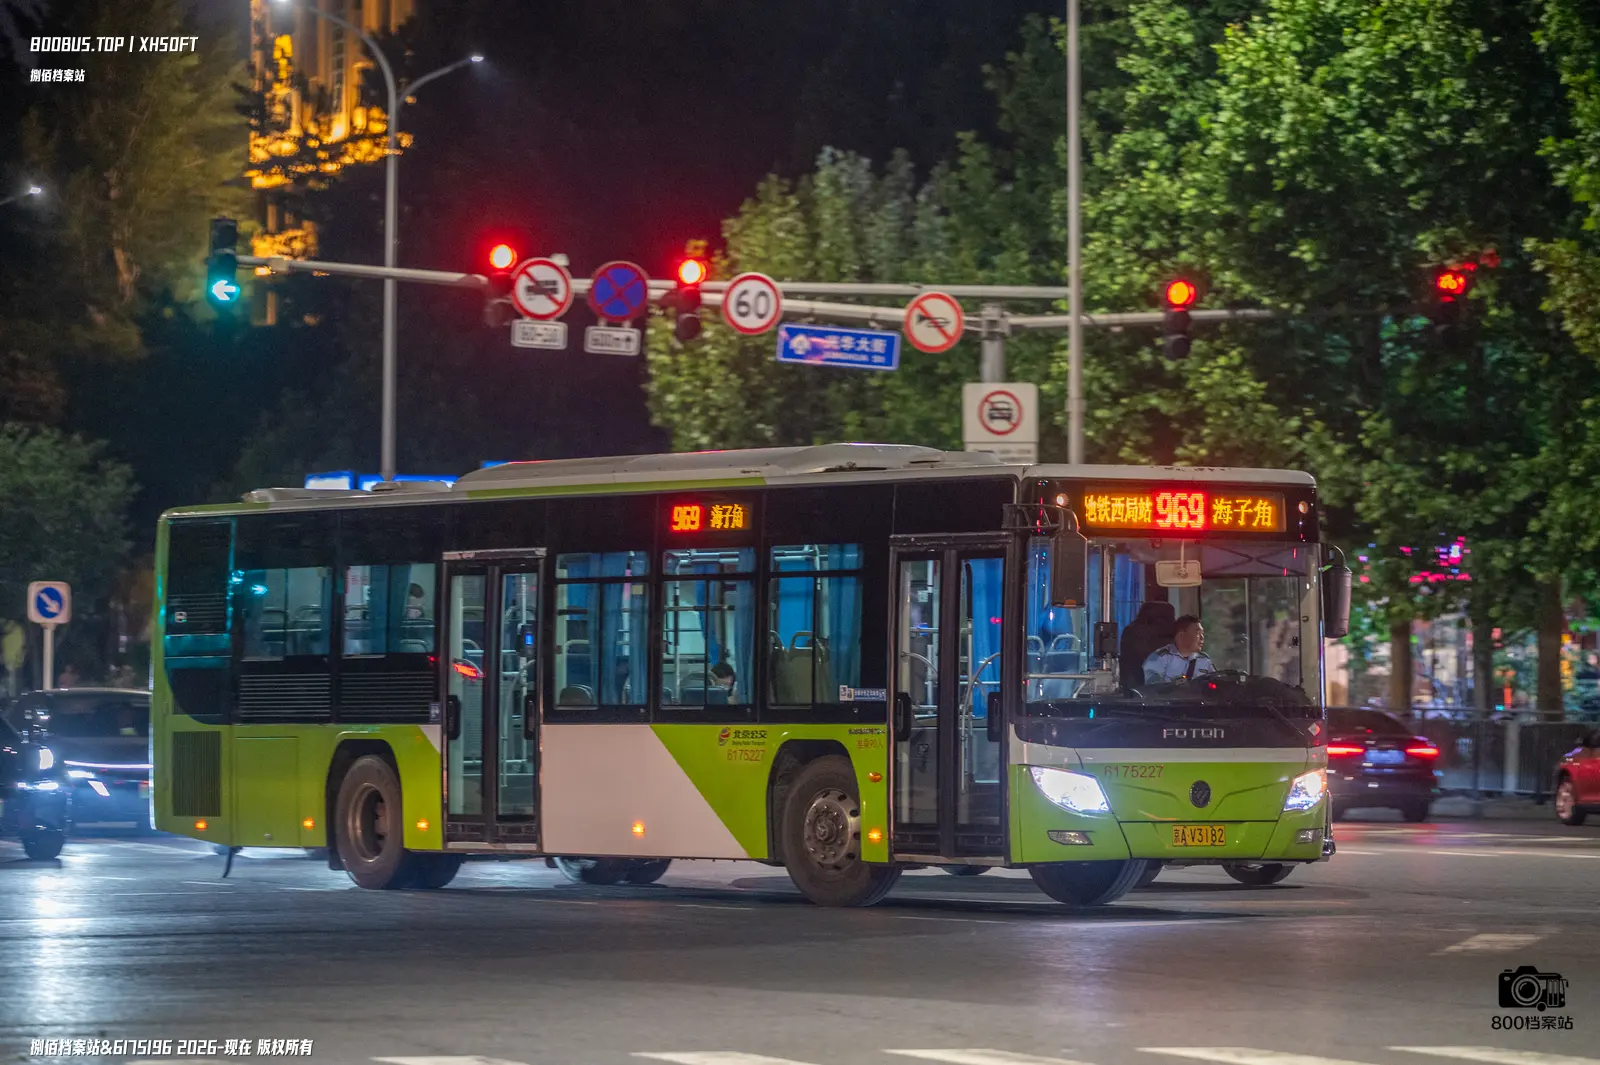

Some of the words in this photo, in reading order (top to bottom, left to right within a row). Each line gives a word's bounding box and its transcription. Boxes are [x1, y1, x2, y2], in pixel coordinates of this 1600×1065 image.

[735, 289, 770, 320] 60
[1084, 495, 1152, 525] 地铁西局站
[1155, 492, 1205, 528] 969
[1212, 498, 1273, 528] 海子角
[732, 729, 768, 739] 北京公交
[1163, 728, 1225, 739] FOTON
[727, 748, 767, 762] 6175227
[1104, 765, 1165, 779] 6175227
